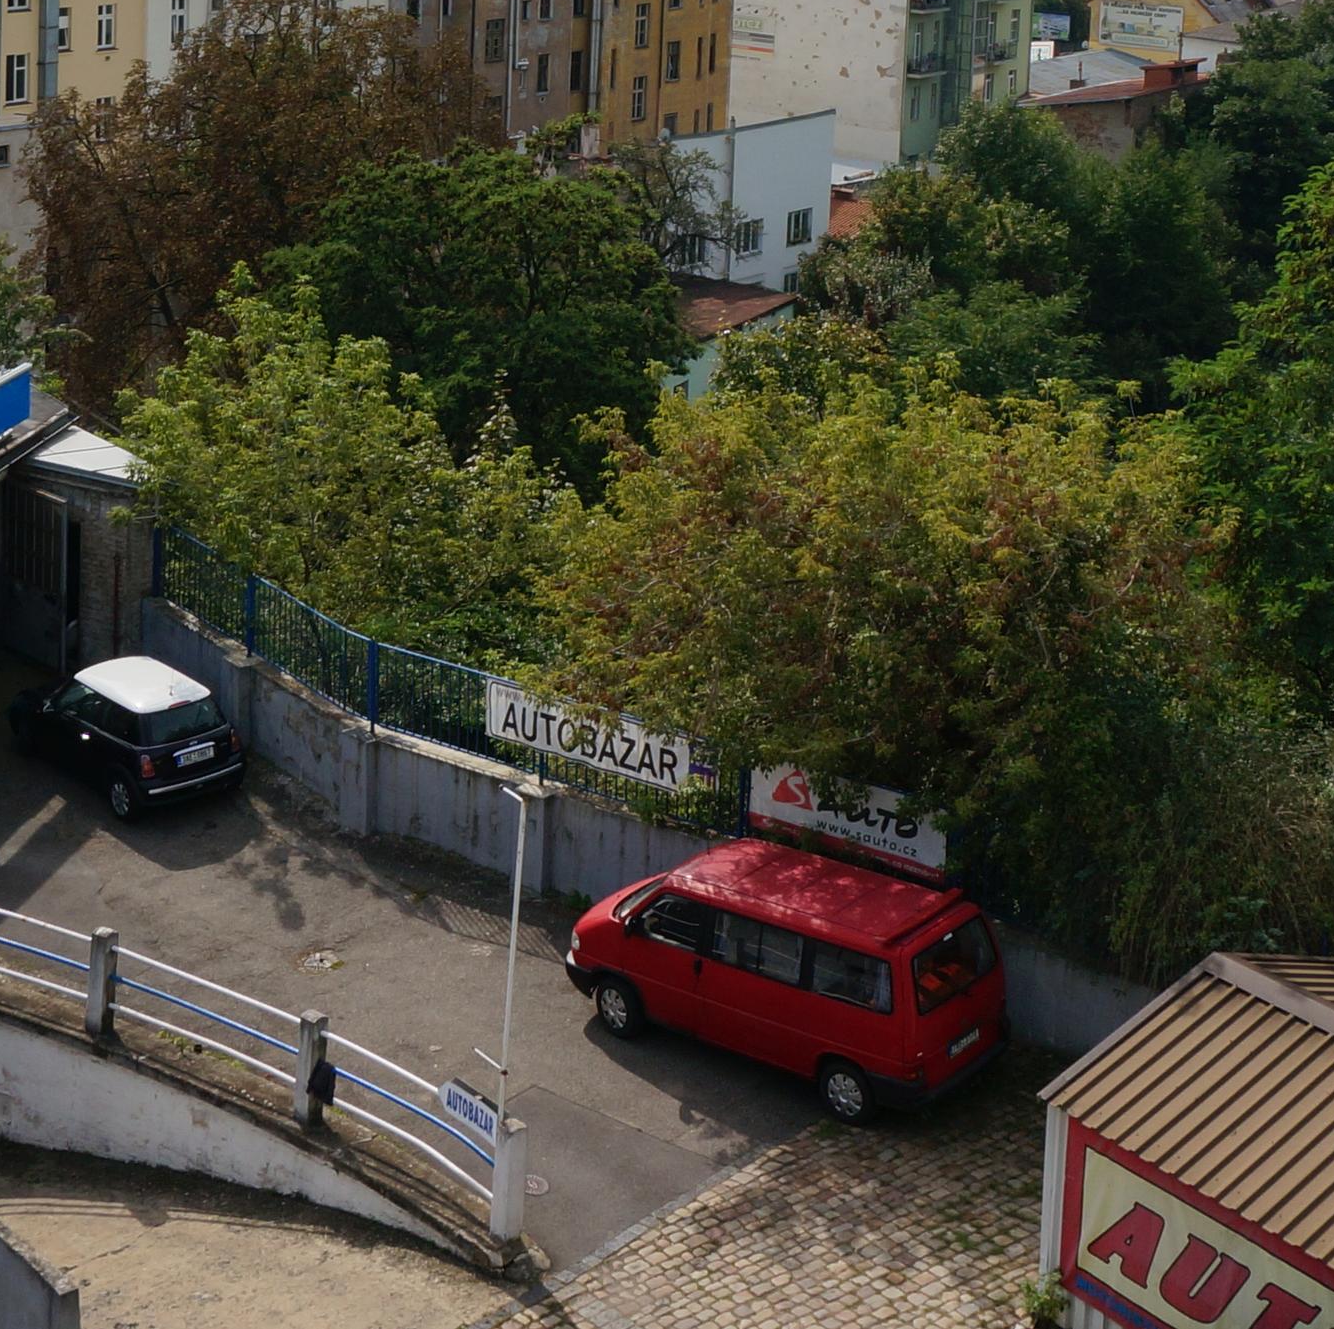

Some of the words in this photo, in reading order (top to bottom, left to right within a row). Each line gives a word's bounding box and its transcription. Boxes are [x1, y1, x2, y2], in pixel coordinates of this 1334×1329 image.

[502, 702, 678, 785] AUTOBAZAR
[816, 820, 918, 857] www.sauto.cz
[446, 1088, 494, 1139] AUTOBAZAR
